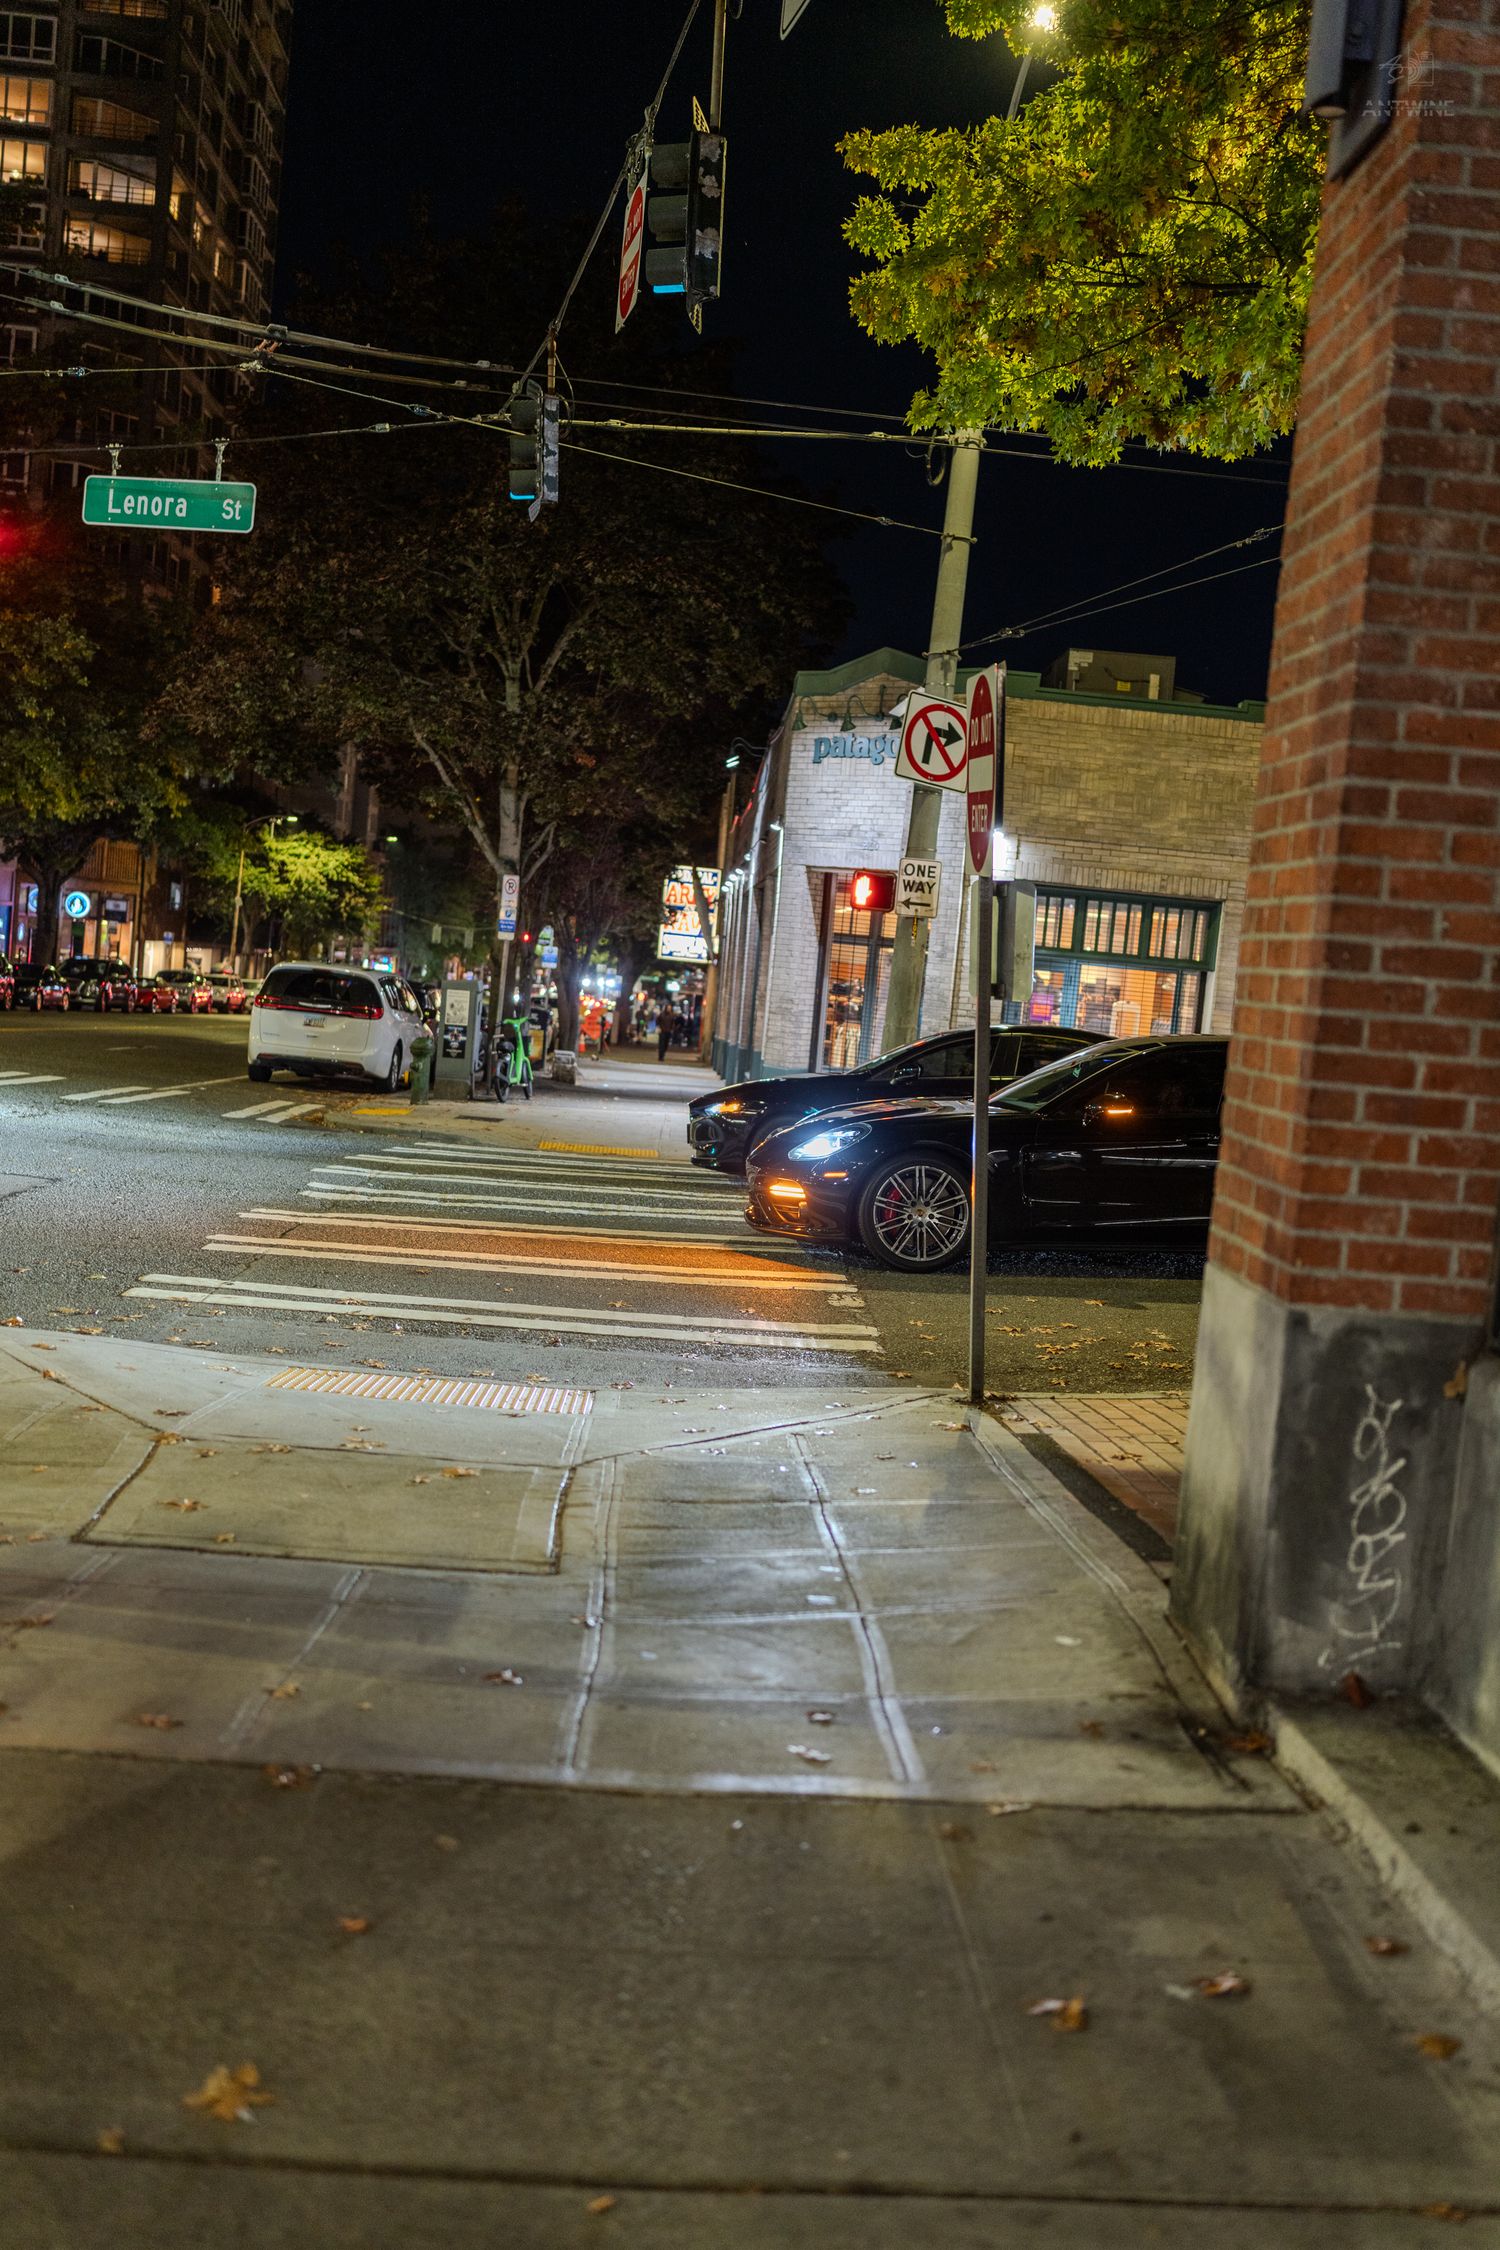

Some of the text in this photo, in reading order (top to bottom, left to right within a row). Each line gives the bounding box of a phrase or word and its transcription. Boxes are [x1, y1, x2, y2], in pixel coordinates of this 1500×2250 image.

[107, 488, 242, 521] Lenora St
[971, 713, 992, 747] DO NOT
[971, 803, 989, 833] ENTER
[904, 863, 937, 878] ONE
[902, 879, 937, 896] WAY
